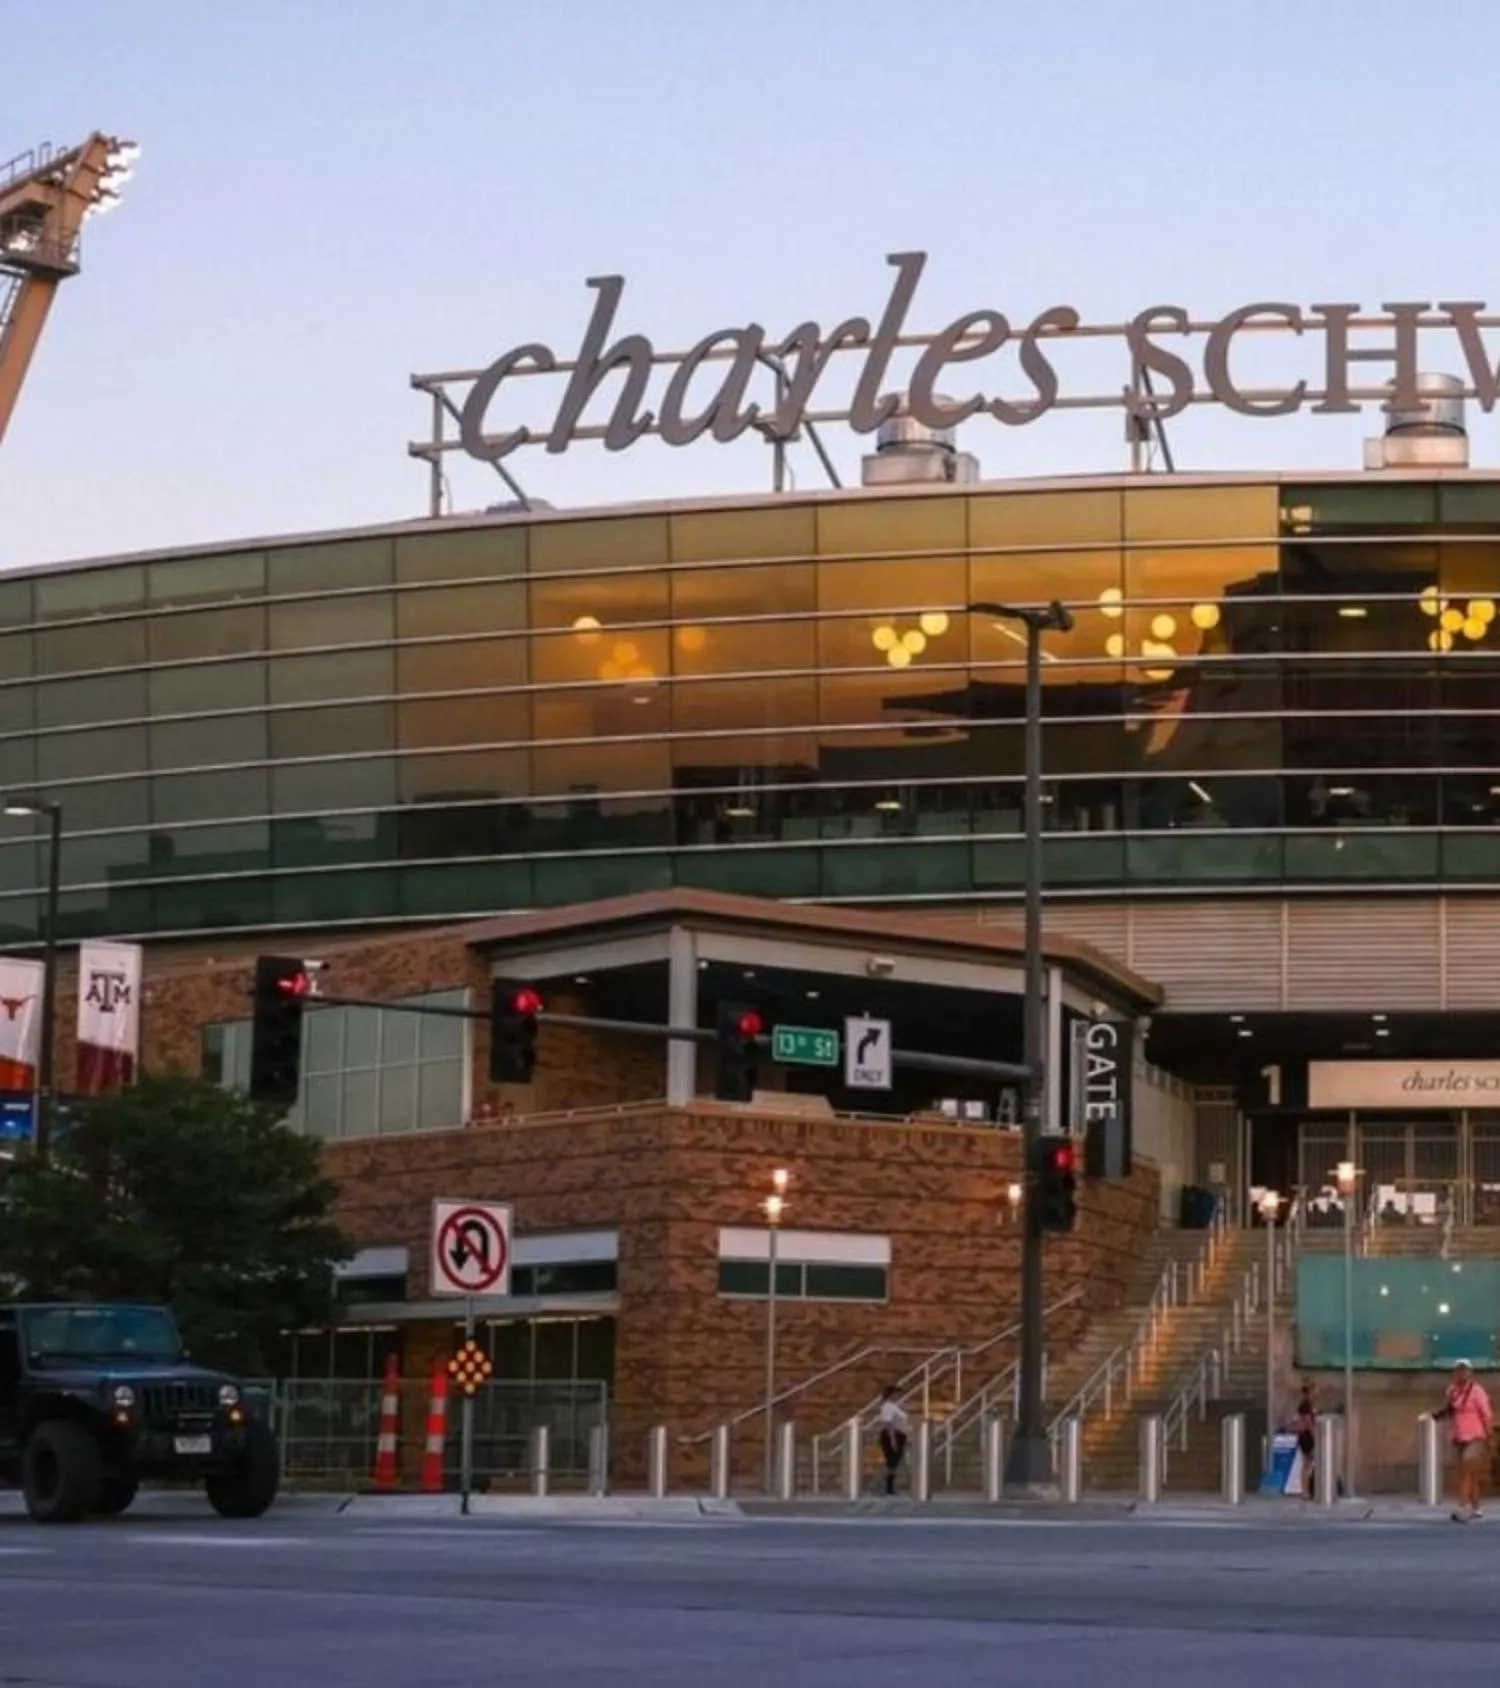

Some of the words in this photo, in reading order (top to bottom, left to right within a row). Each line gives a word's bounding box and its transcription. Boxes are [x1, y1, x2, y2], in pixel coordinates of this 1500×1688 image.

[460, 251, 1080, 461] charles
[1085, 1022, 1118, 1120] GATE
[1260, 1065, 1281, 1105] 1
